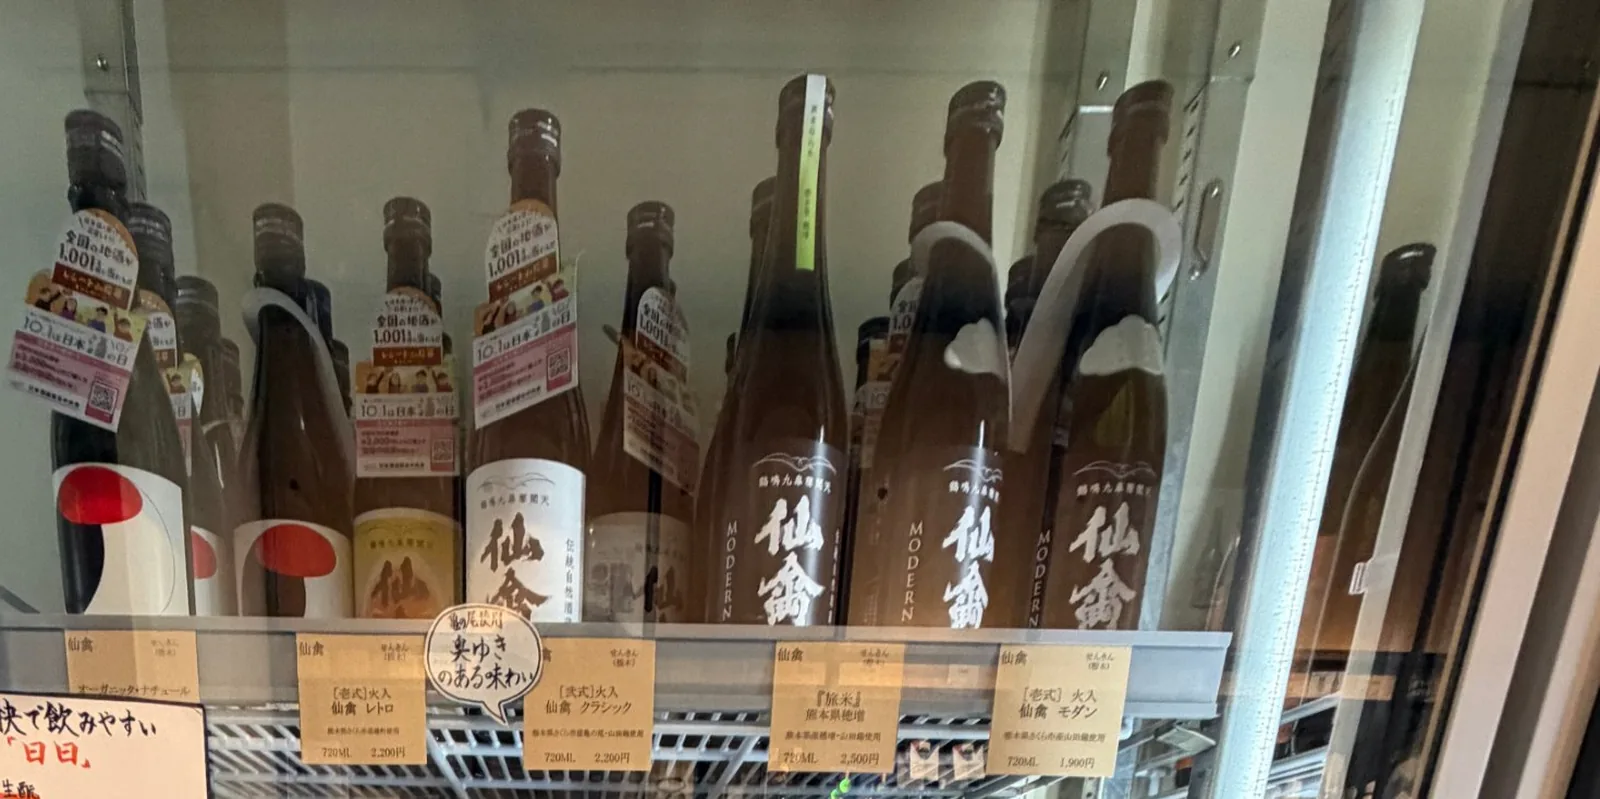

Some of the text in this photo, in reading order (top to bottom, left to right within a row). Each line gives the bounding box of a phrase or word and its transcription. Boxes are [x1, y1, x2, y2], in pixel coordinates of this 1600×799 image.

[722, 521, 738, 621] MODERN
[901, 521, 923, 621] MODERN
[1029, 530, 1051, 627] MODERN
[68, 637, 93, 652] 仙禽
[300, 641, 324, 656] 仙禽
[450, 634, 507, 663] 奥ゆき
[778, 647, 803, 661] 仙禽
[1001, 650, 1027, 666] 仙禽
[438, 663, 534, 690] のある味わい
[1072, 688, 1097, 702] 火入
[332, 701, 394, 716] 仙禽 レトロ
[546, 700, 632, 715] 仙禽 クラシック
[1019, 703, 1097, 719] 仙禽 モダン
[322, 747, 406, 759] 720ML 2,200円
[544, 752, 630, 764] 720ML 2,200円
[840, 752, 880, 765] 2,500円
[1007, 756, 1096, 769] 720ML 1,900円
